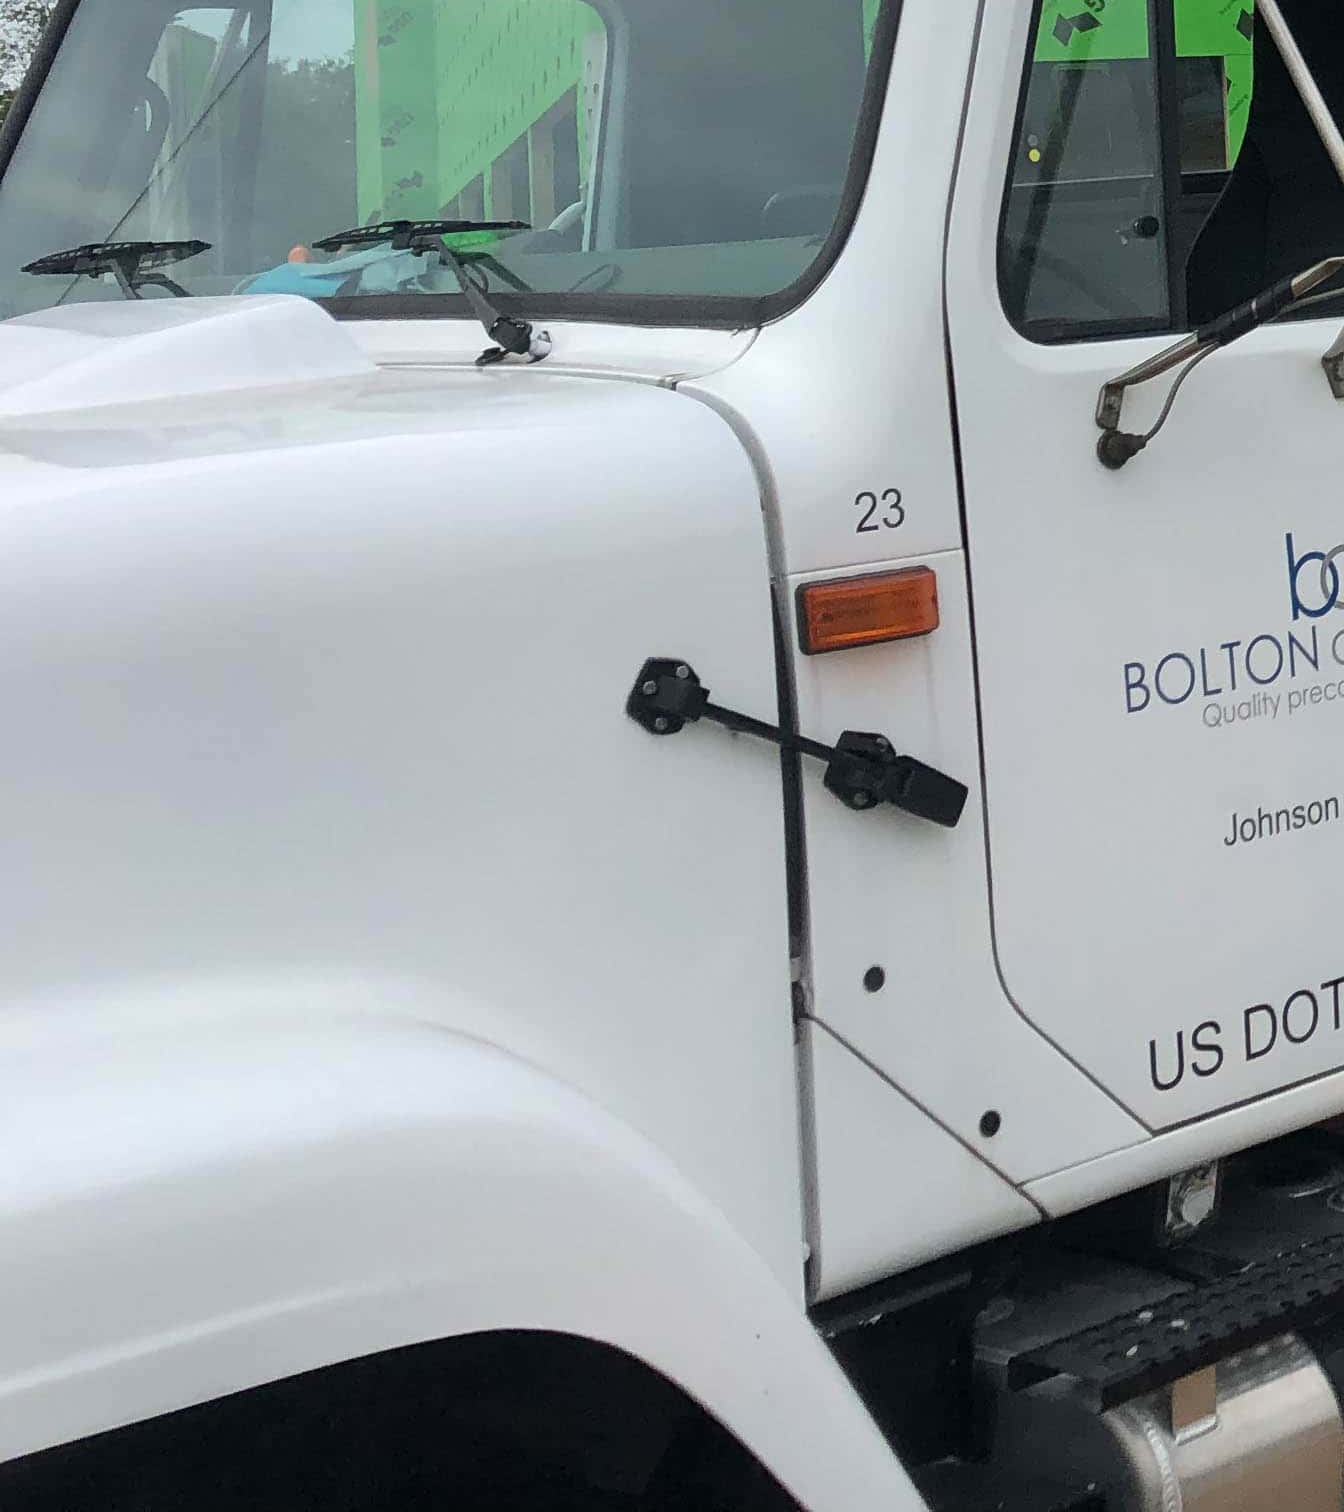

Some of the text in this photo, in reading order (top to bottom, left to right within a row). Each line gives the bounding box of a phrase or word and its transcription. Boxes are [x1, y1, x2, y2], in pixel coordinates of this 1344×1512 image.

[853, 487, 907, 535] 23
[1123, 624, 1321, 714] BOLTON
[1202, 691, 1282, 728] Quality
[1223, 796, 1341, 847] Johnson
[1148, 1020, 1225, 1093] US
